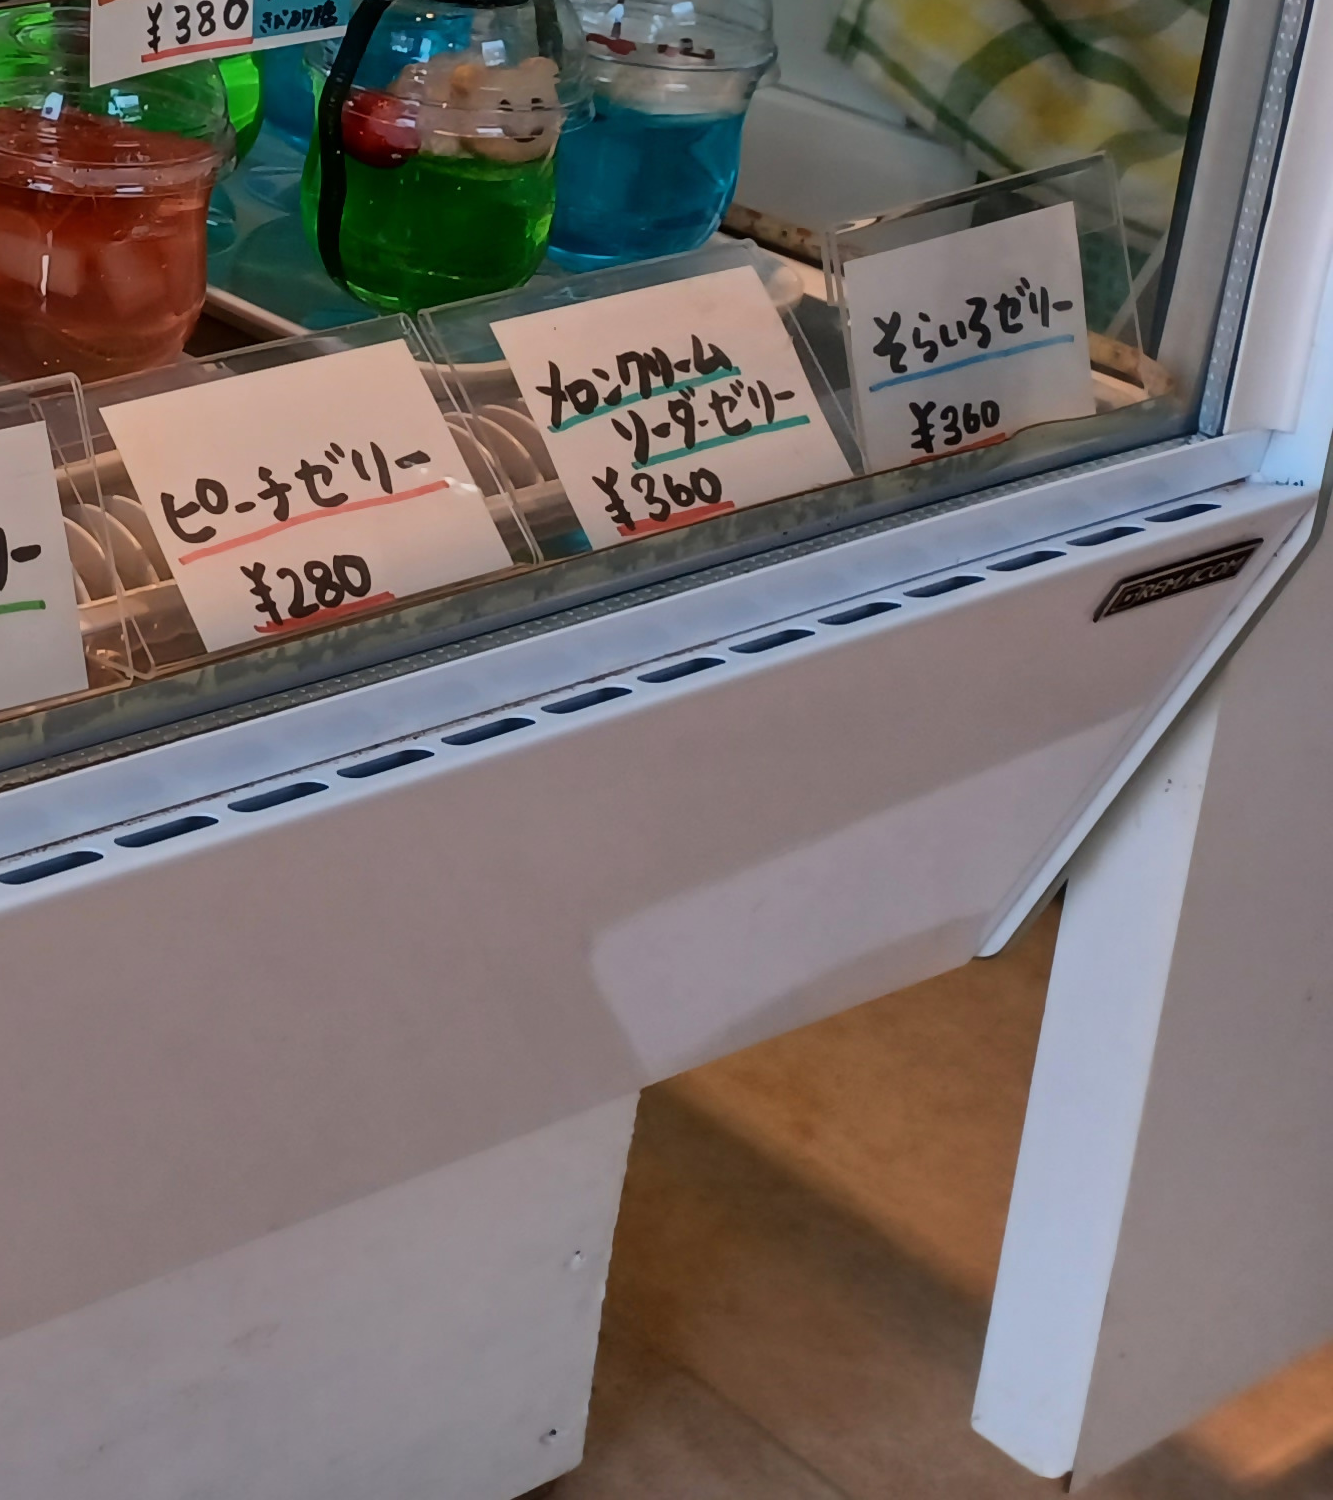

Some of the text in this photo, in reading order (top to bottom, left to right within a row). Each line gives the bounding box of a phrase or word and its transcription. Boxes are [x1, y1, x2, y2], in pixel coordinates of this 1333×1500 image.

[872, 277, 1073, 374] そらいろゼリー
[535, 334, 733, 430] メロンクリーム
[908, 400, 1001, 454] ¥360
[160, 441, 431, 544] ピーチゼリー
[591, 466, 723, 531] ¥360
[240, 555, 372, 626] ¥280
